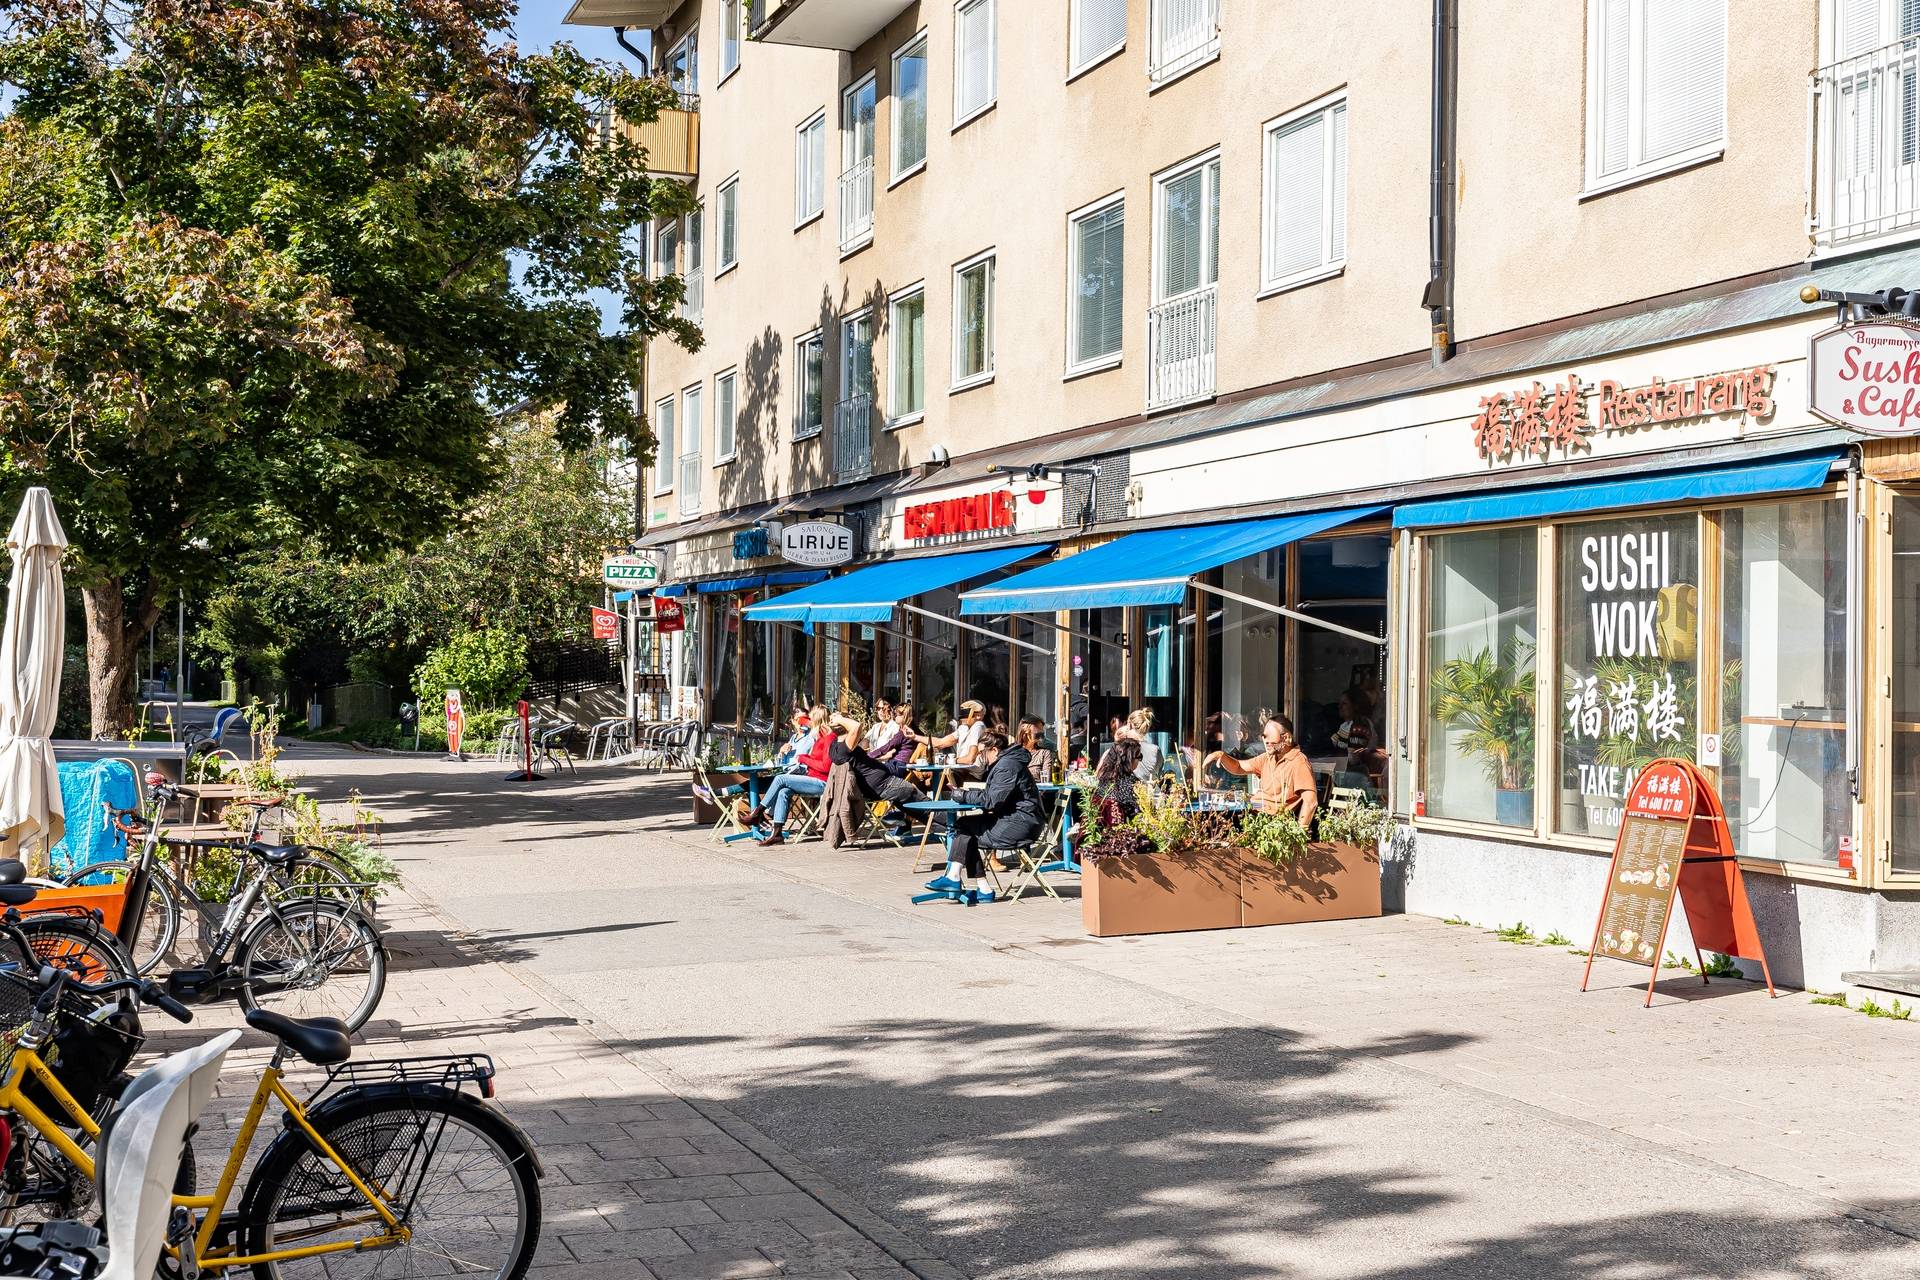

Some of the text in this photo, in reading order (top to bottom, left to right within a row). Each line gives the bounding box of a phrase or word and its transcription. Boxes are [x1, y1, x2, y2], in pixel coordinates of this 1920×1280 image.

[1599, 367, 1774, 430] Restaurang
[1842, 399, 1855, 414] &
[801, 525, 834, 535] SALONG
[787, 534, 849, 550] LIRIJE
[1581, 531, 1669, 592] SUSHI
[608, 567, 653, 577] PIZZA
[1591, 601, 1659, 657] WOK
[1578, 764, 1619, 798] TAKE
[1637, 796, 1649, 809] Tel
[1648, 797, 1663, 810] 600
[1588, 805, 1604, 825] Tel
